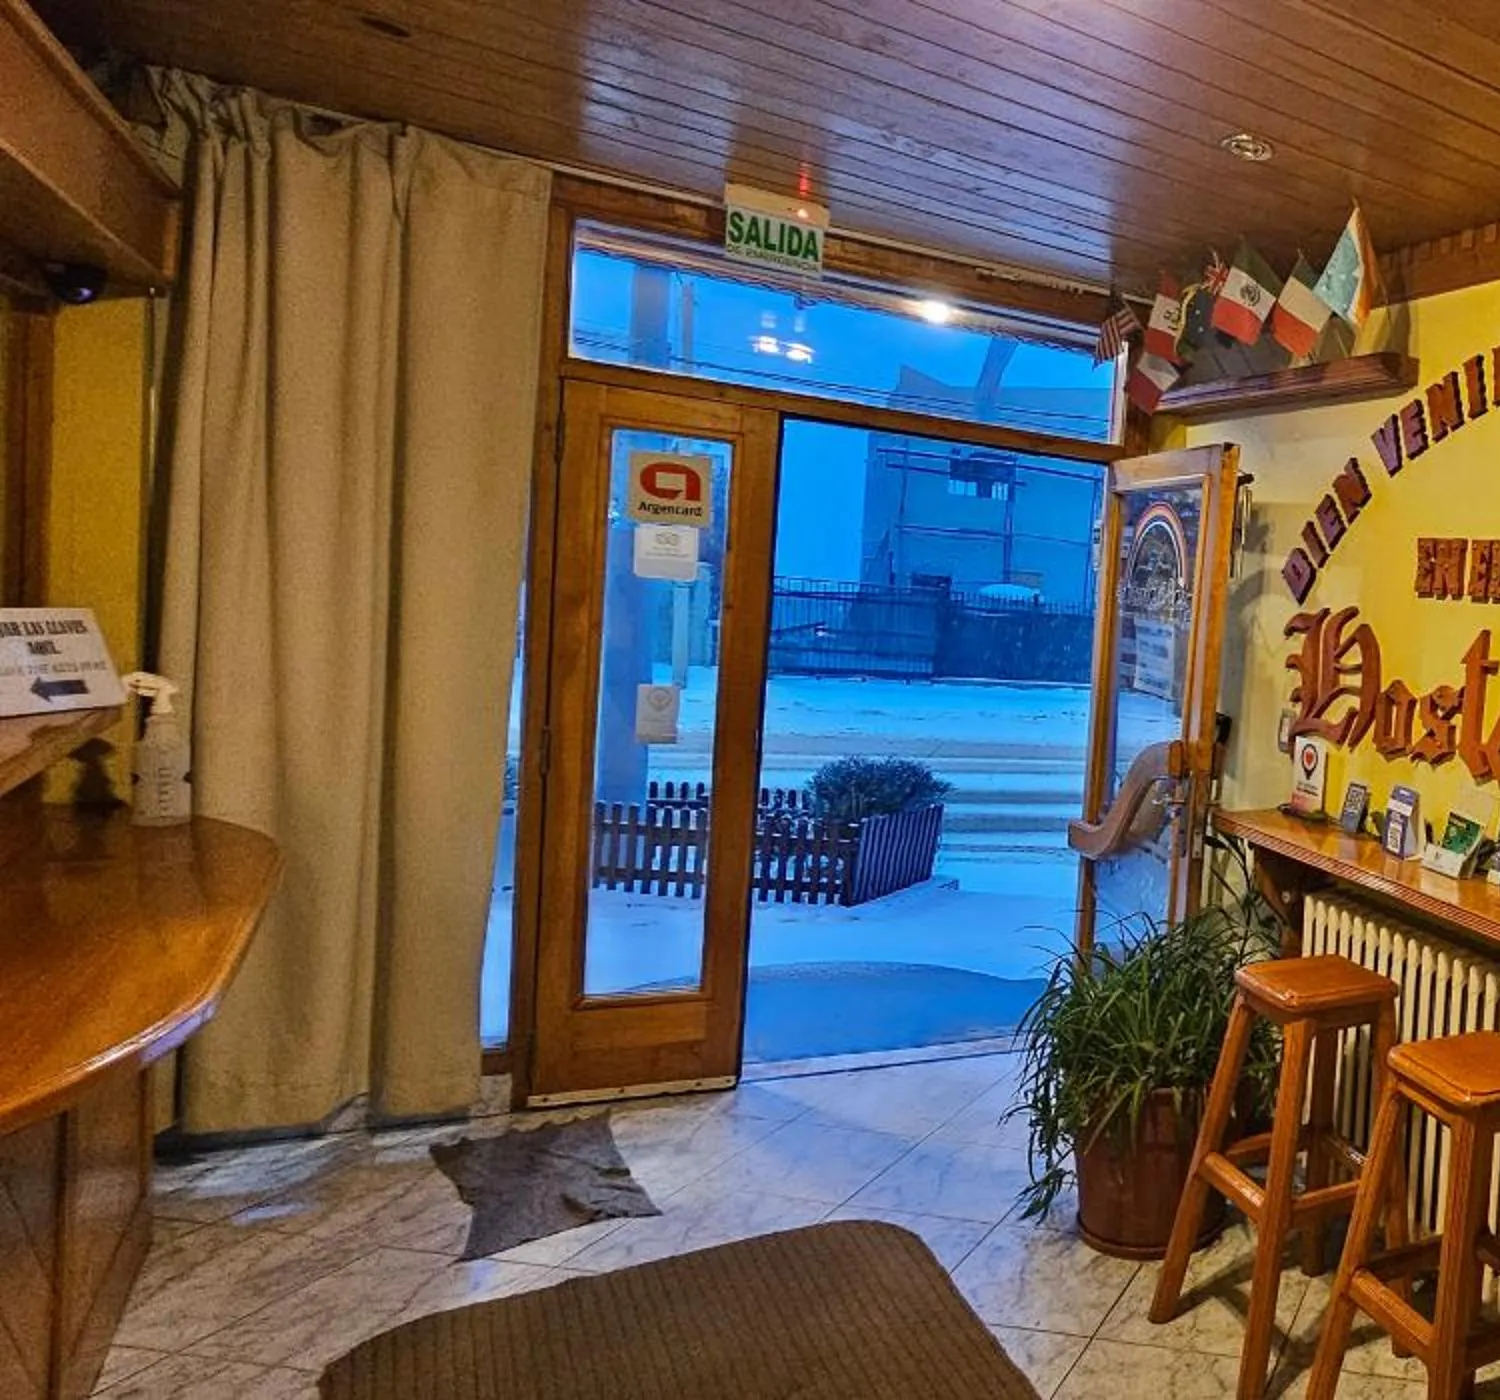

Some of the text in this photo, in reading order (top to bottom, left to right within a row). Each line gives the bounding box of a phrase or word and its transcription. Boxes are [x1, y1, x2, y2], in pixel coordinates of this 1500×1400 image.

[728, 211, 819, 262] SALIDA
[637, 501, 702, 517] Argencard
[1414, 537, 1467, 600] EN
